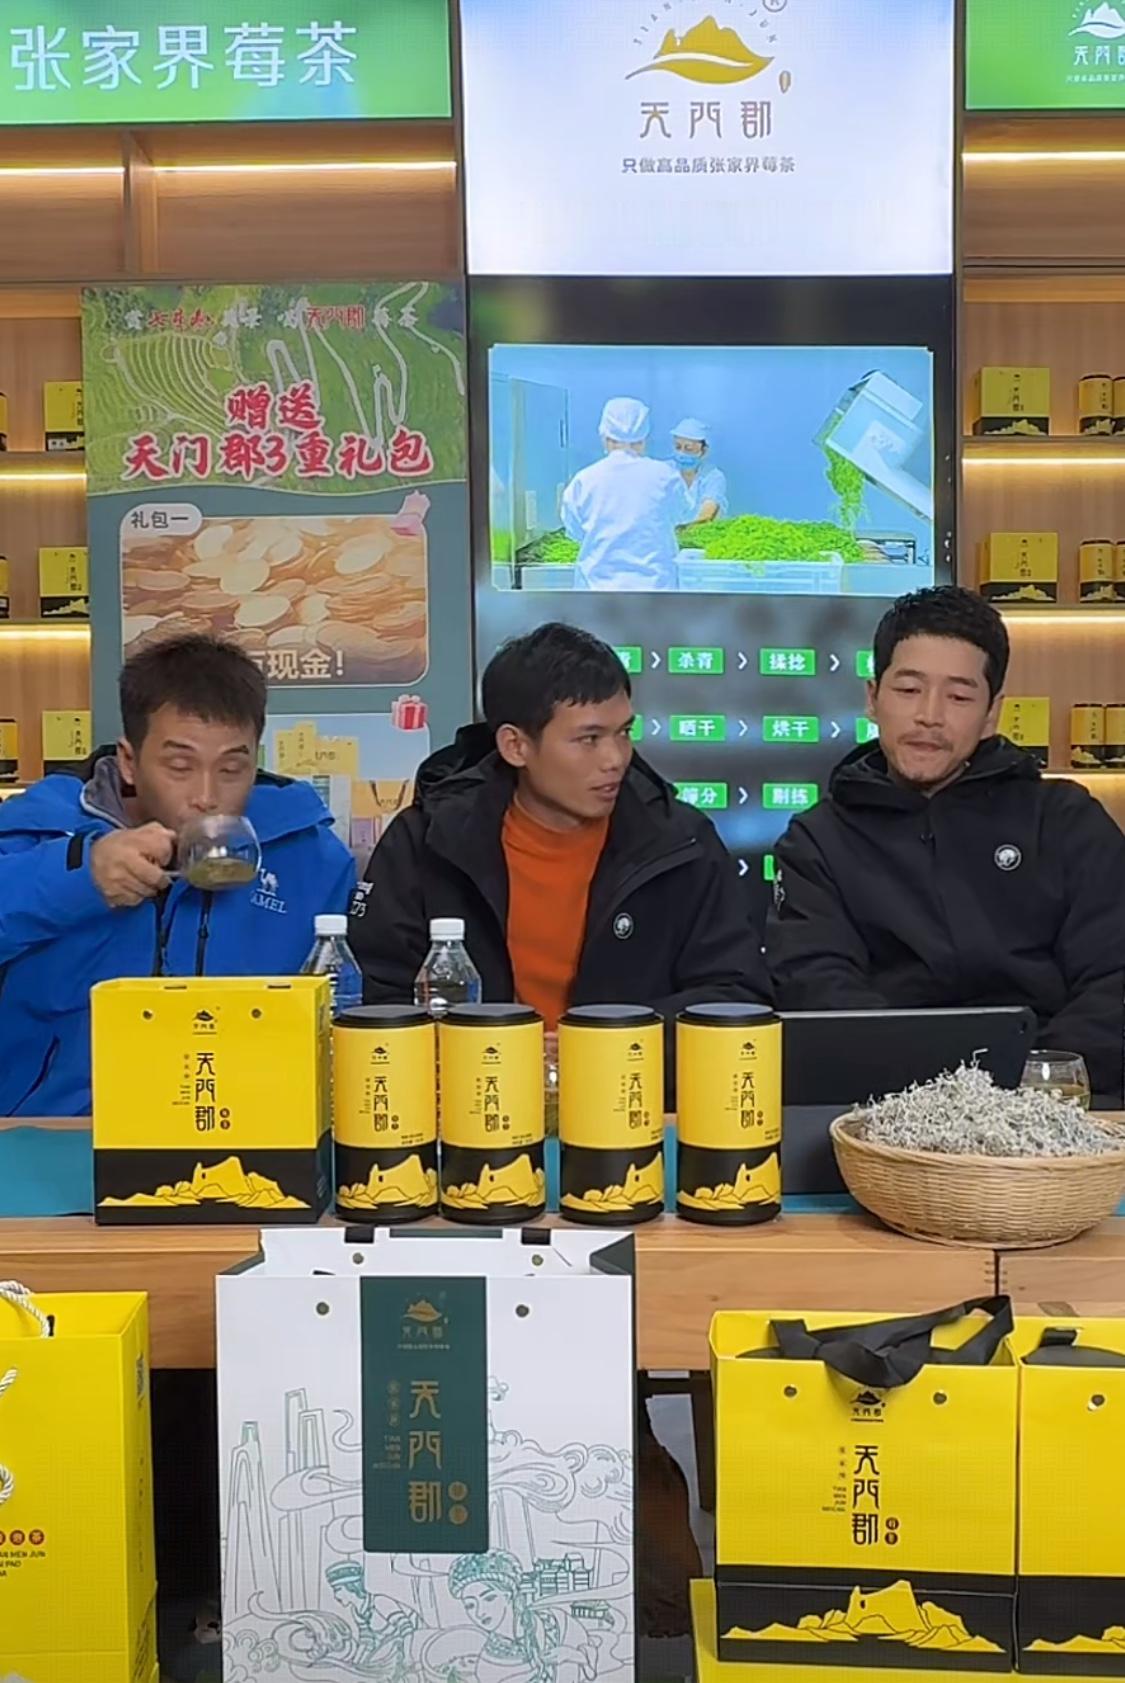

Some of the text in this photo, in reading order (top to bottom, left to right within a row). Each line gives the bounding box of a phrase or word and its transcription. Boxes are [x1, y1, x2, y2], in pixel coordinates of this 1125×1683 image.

[9, 22, 358, 91] 张家界莓茶
[621, 156, 796, 174] 只做高品质张家界莓茶
[226, 381, 323, 431] 赠送
[123, 427, 433, 480] 天门郡3重礼包
[131, 511, 189, 529] 礼包一
[678, 652, 713, 669] 杀青
[679, 719, 715, 736] 晒干
[772, 720, 809, 738] 烘干
[249, 893, 288, 915] AMEL
